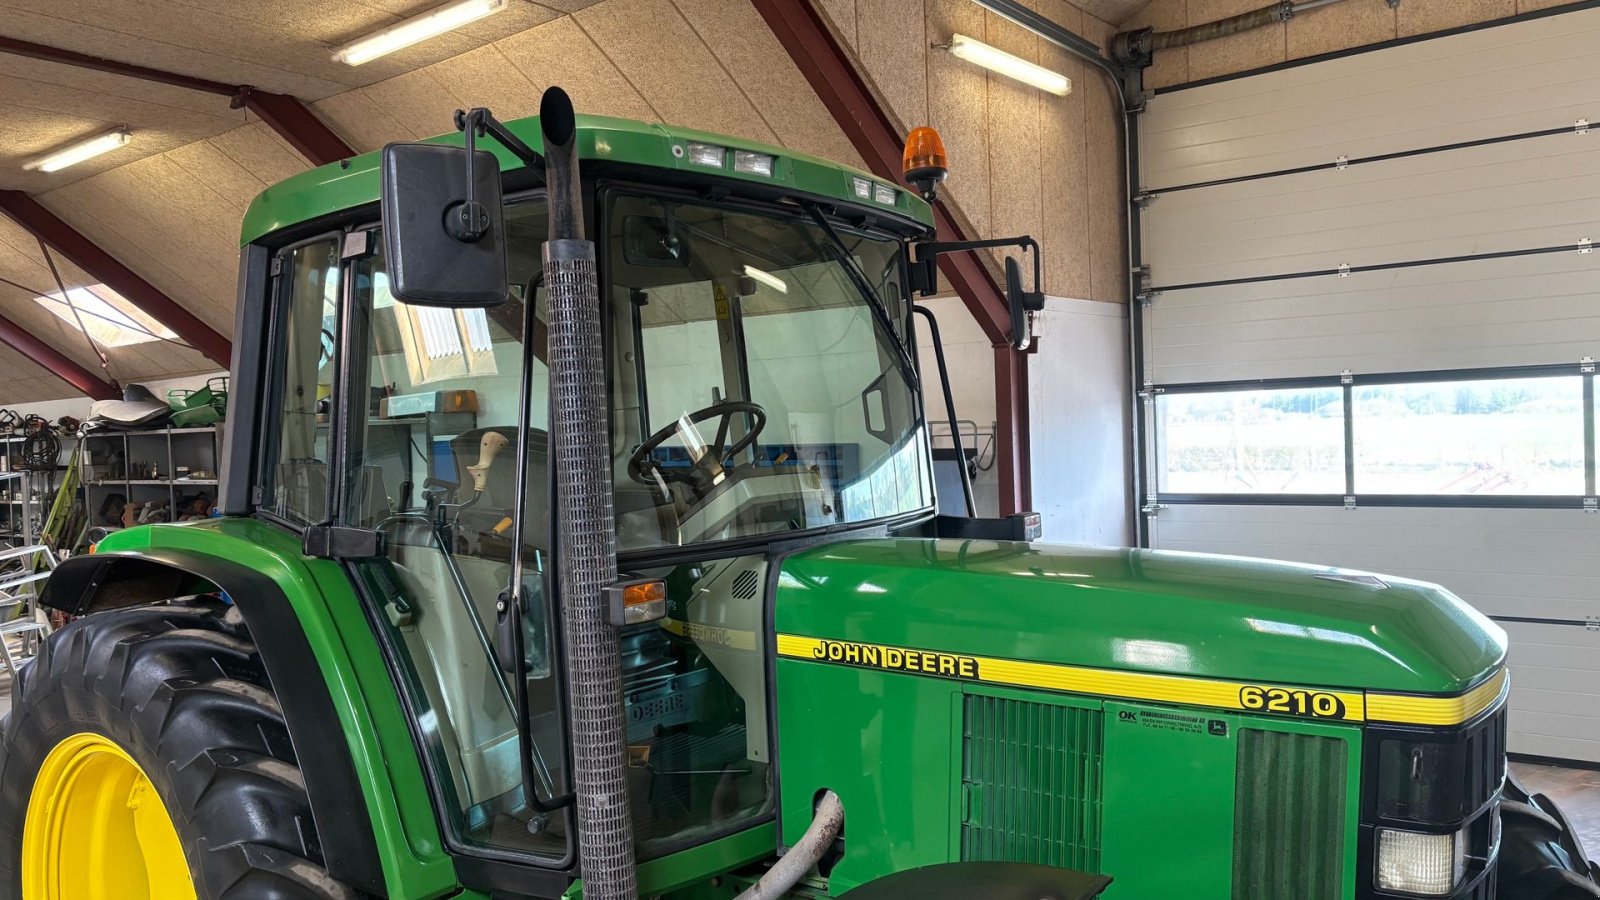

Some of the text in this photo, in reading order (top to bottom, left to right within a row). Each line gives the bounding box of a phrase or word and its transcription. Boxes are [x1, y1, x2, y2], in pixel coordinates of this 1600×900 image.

[813, 641, 979, 679] JOHN DEERE
[1118, 710, 1137, 721] OK
[1239, 686, 1345, 719] 6210
